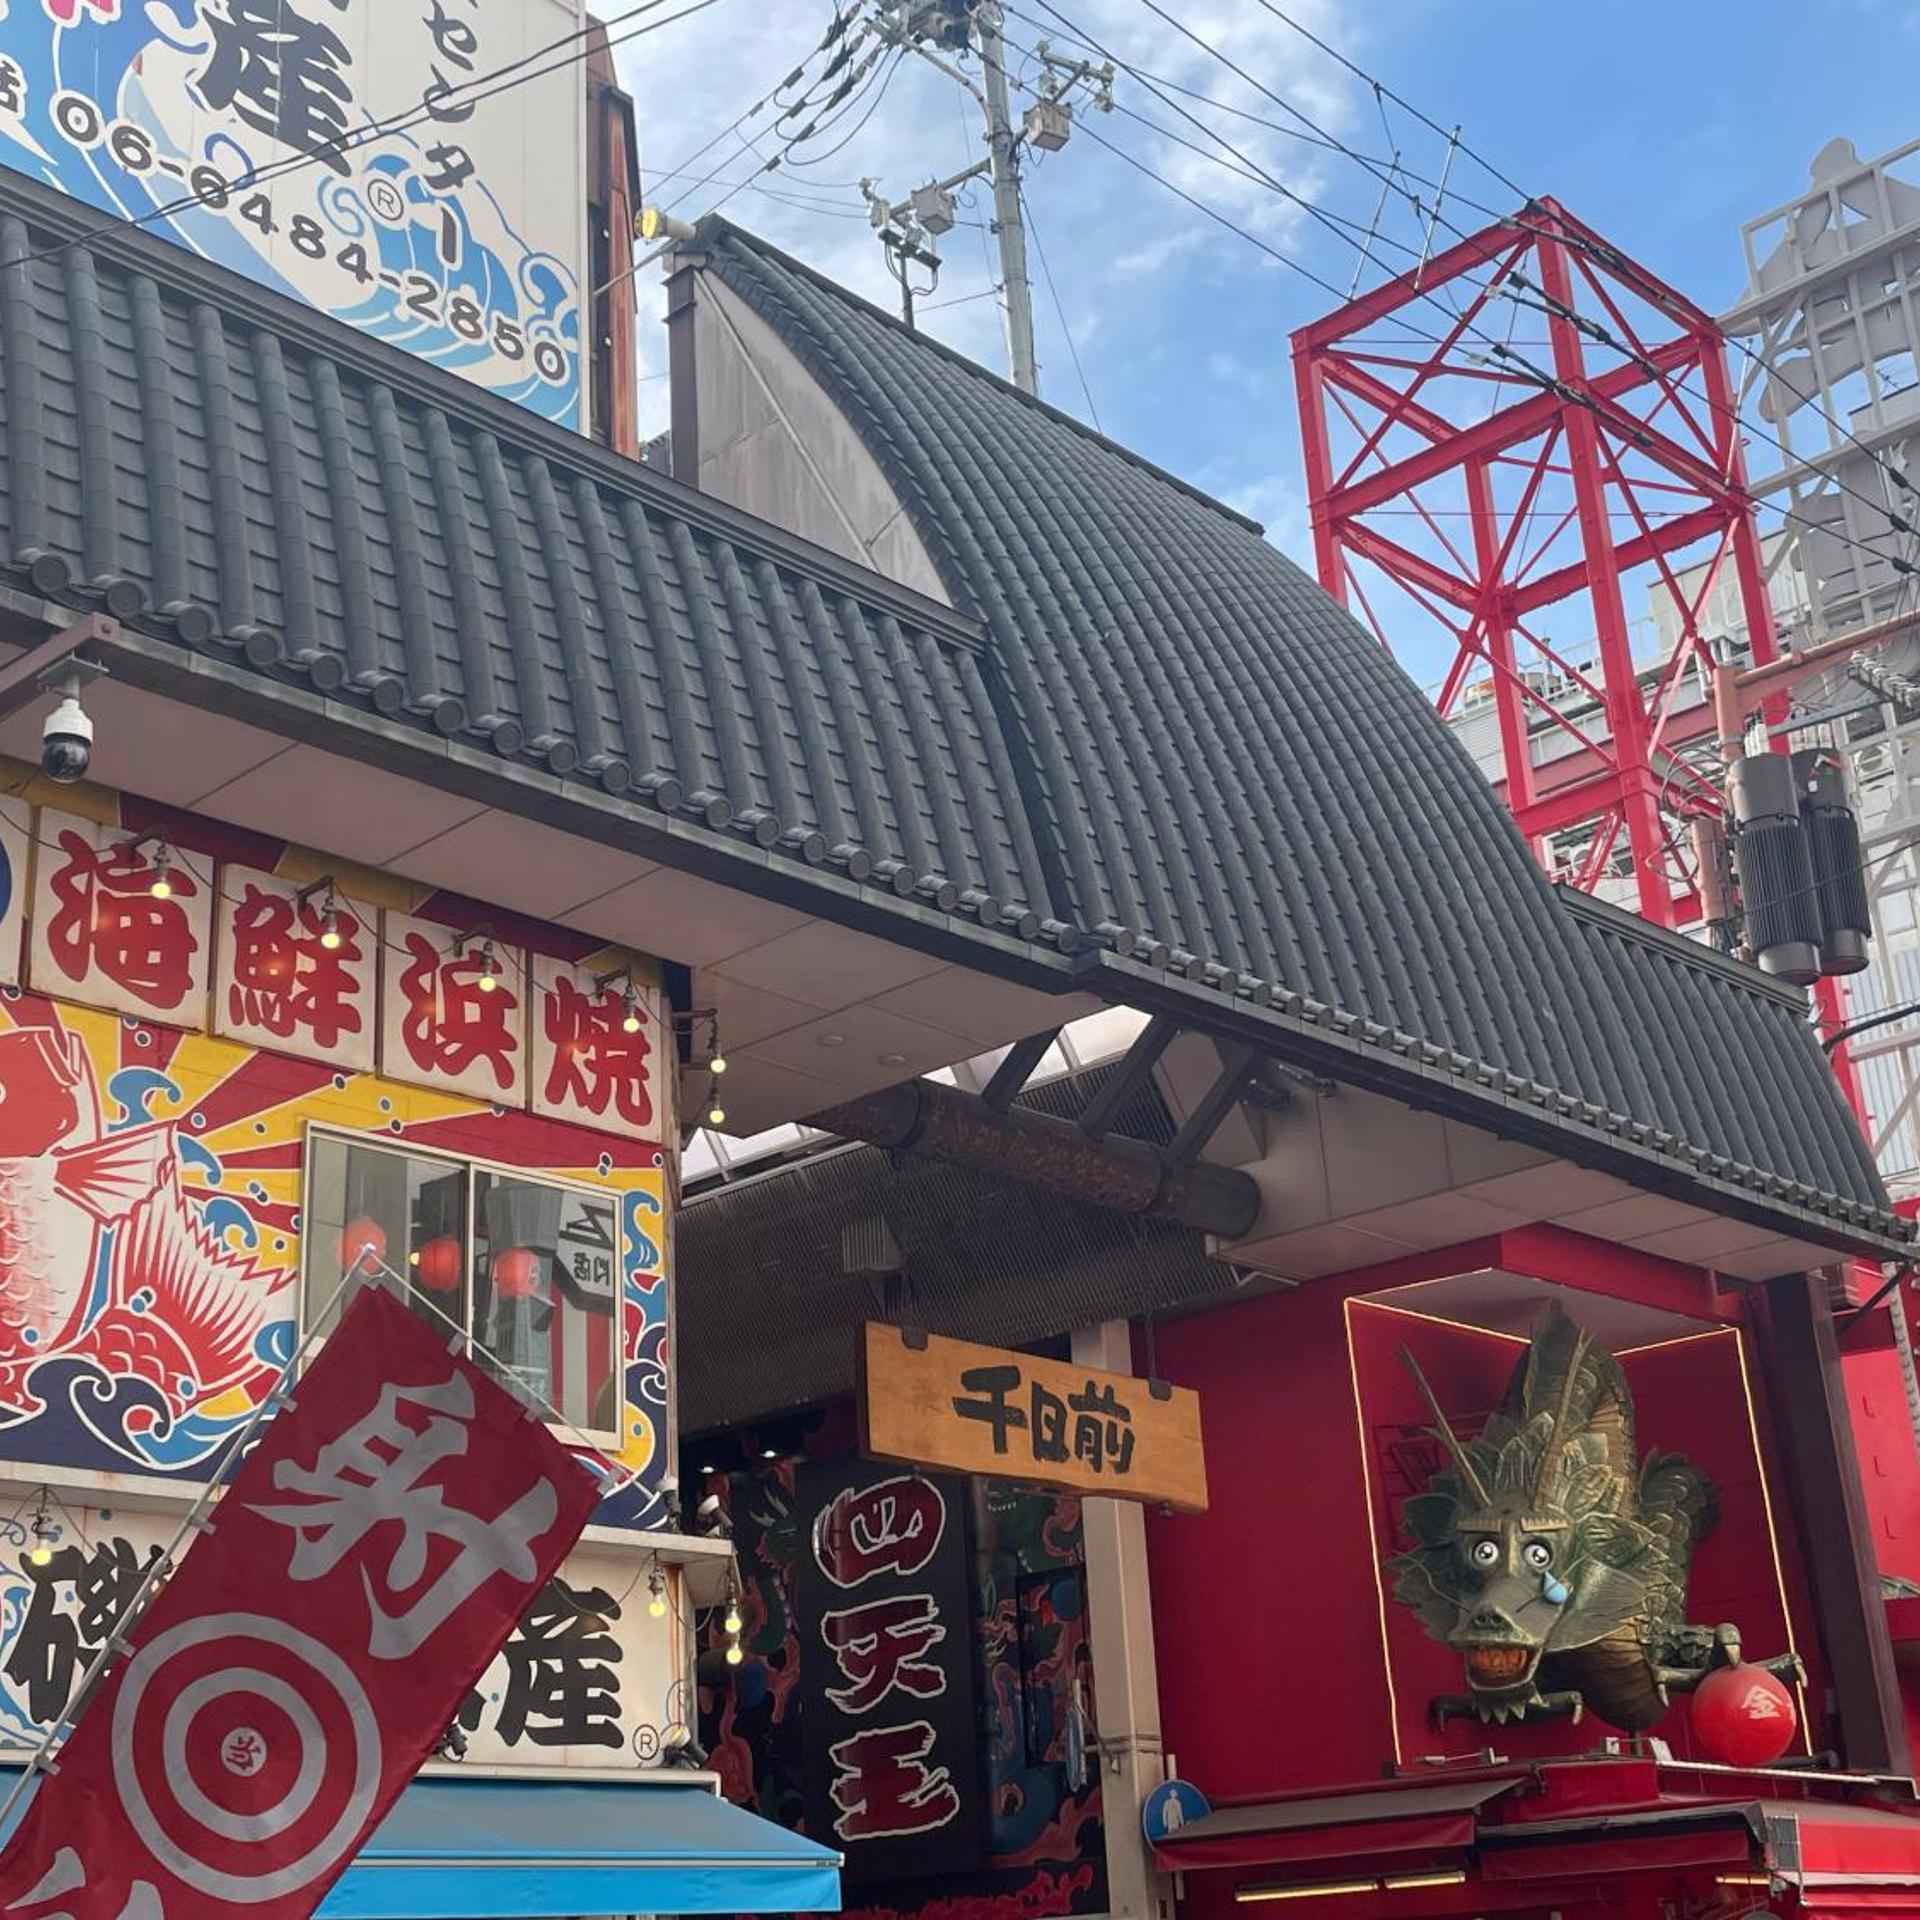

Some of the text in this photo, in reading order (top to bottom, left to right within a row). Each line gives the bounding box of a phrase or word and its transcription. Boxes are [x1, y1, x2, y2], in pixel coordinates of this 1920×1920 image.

[56, 96, 565, 381] 06-6484-2850
[47, 828, 653, 1127] 海鮮浜焼
[952, 1364, 1136, 1474] 千日前
[811, 1474, 961, 1842] 四天王
